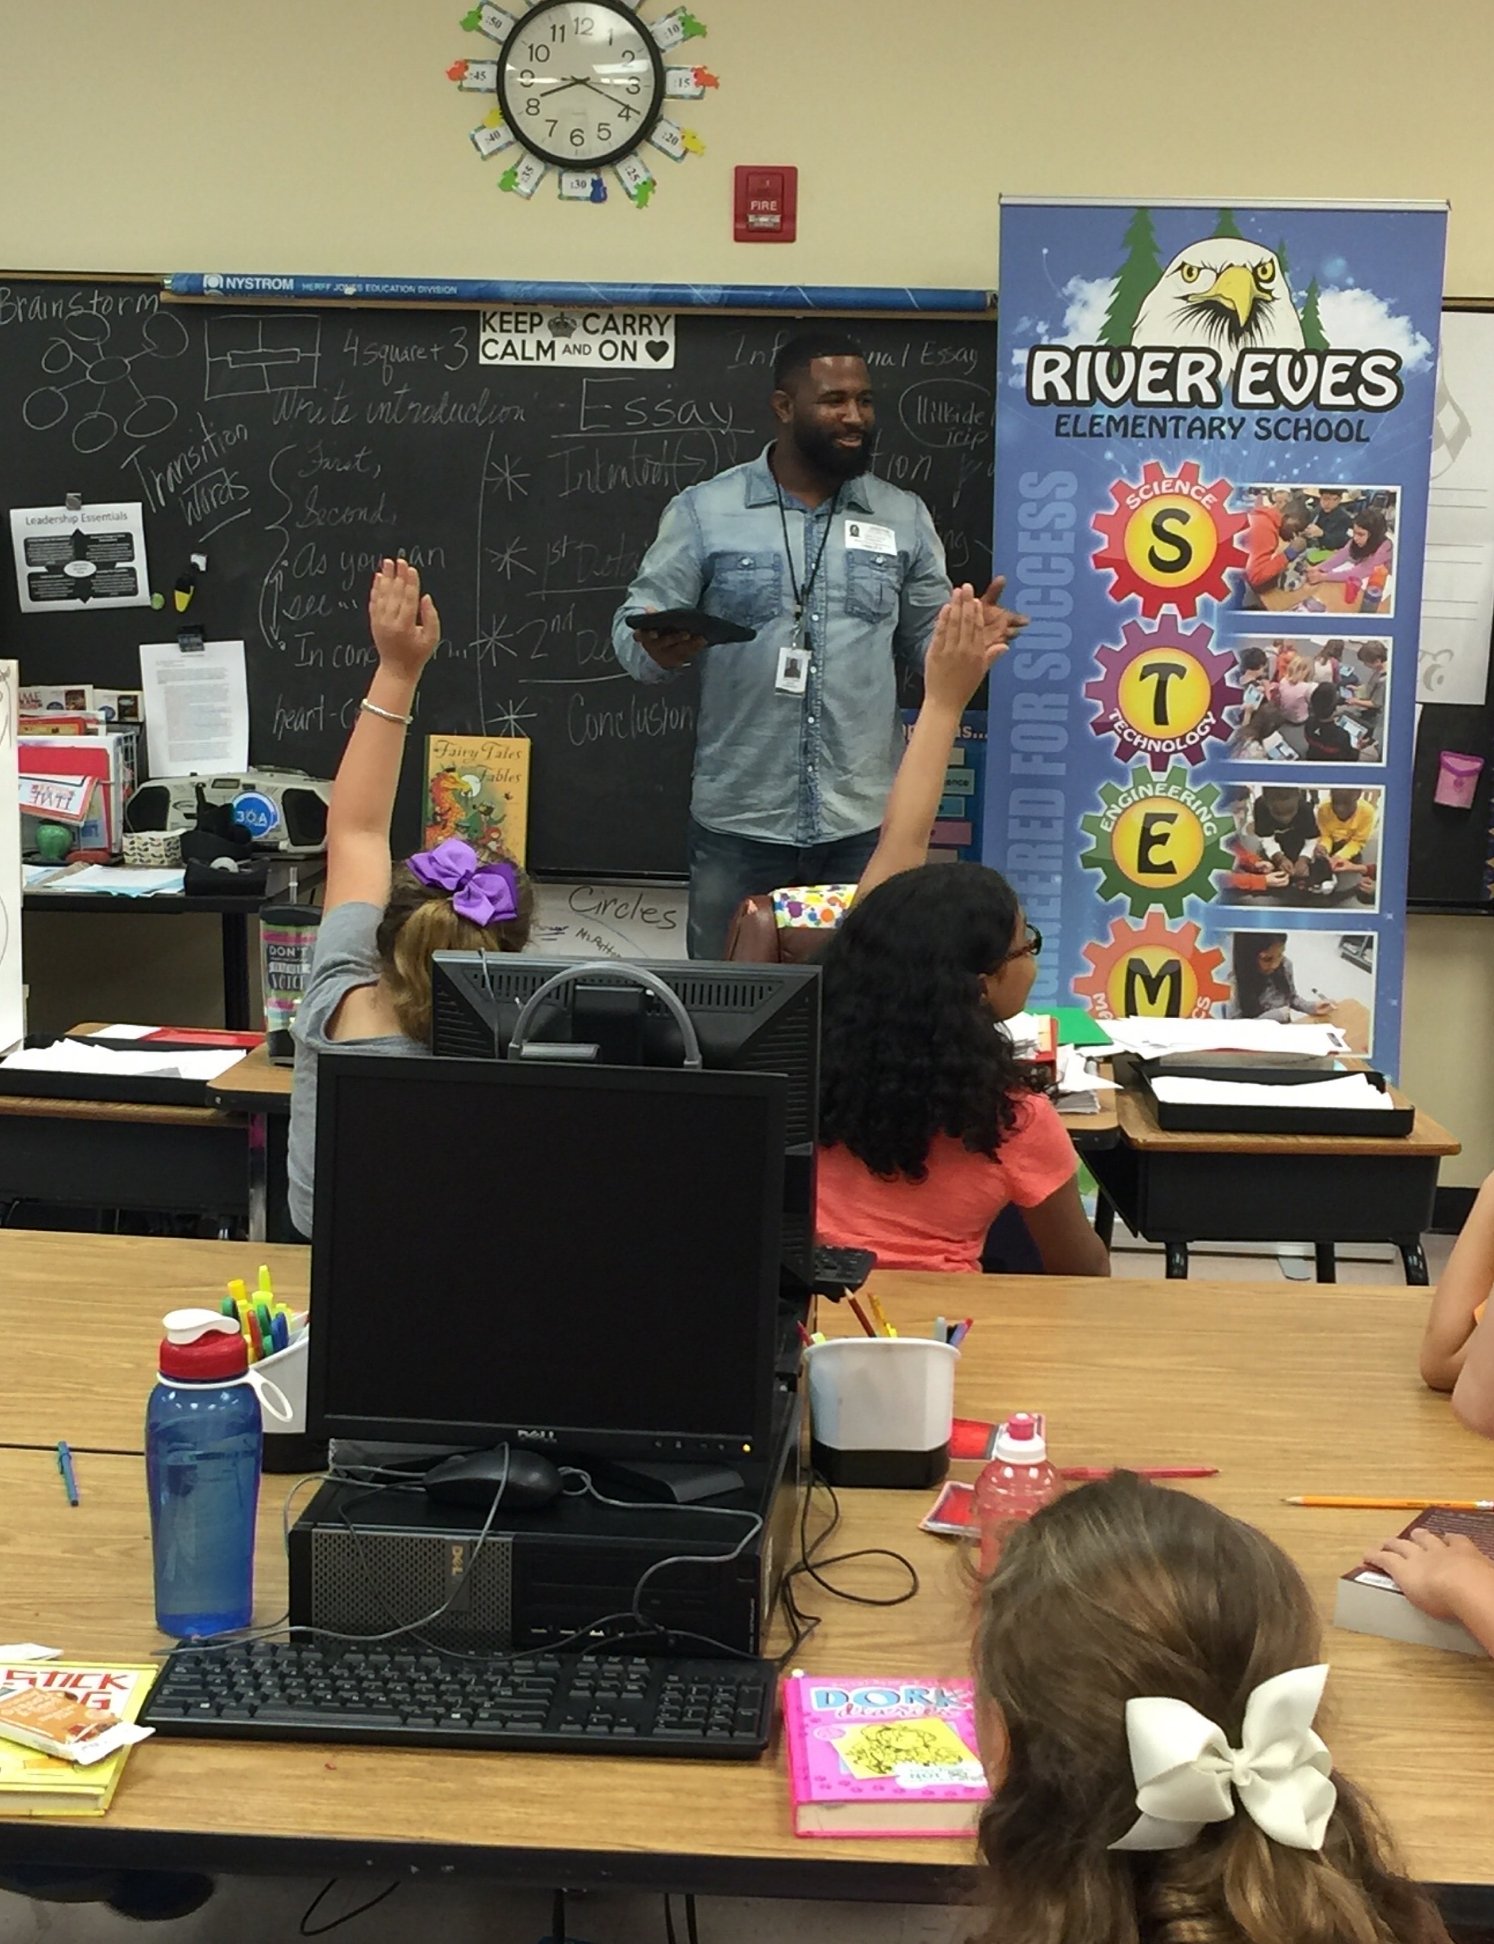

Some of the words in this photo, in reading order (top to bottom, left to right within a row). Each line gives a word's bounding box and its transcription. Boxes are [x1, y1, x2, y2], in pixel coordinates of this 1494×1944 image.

[550, 24, 566, 43] 11
[574, 16, 594, 36] 12
[528, 43, 550, 62] 10
[621, 50, 636, 68] 2
[625, 76, 641, 95] 3
[525, 98, 540, 116] 8
[617, 104, 632, 122] 4
[545, 119, 559, 137] 7
[569, 128, 585, 147] 6
[597, 122, 612, 141] 5
[750, 200, 777, 211] FIRE
[225, 277, 295, 291] NYSTROM
[365, 284, 416, 294] EDUCATION
[417, 285, 458, 295] DIVISION
[0, 286, 159, 325] Brainstorm
[481, 311, 543, 334] KEEP
[582, 313, 672, 336] CARRY
[481, 338, 556, 362] CALM
[561, 343, 592, 356] AND
[598, 339, 637, 362] ON
[1029, 347, 1221, 407] RIVER
[1235, 351, 1402, 410] EVES
[580, 377, 734, 435] Essay
[1055, 414, 1246, 442] ELEMENTARY
[1253, 416, 1371, 443] SCHOOL
[121, 411, 249, 513] Transition
[1125, 479, 1218, 511] SCIENCE
[25, 515, 79, 527] Leadership
[80, 511, 129, 524] Essentials
[1147, 507, 1193, 574] S
[1013, 468, 1079, 682] SUCCESS
[1138, 661, 1188, 726] T
[567, 691, 694, 746] Conclusion
[1108, 707, 1217, 753] TECHNOLOGY
[1009, 691, 1071, 776] FOR
[433, 739, 479, 764] Fairy
[480, 740, 523, 760] Tales
[1099, 782, 1218, 837] ENGINEERING
[1137, 812, 1179, 875] E
[568, 885, 677, 930] Circles
[269, 944, 309, 957] DON'T
[1124, 957, 1183, 1018] M
[517, 1429, 558, 1443] DELL
[2, 1669, 128, 1690] STICK
[811, 1686, 973, 1712] DORK
